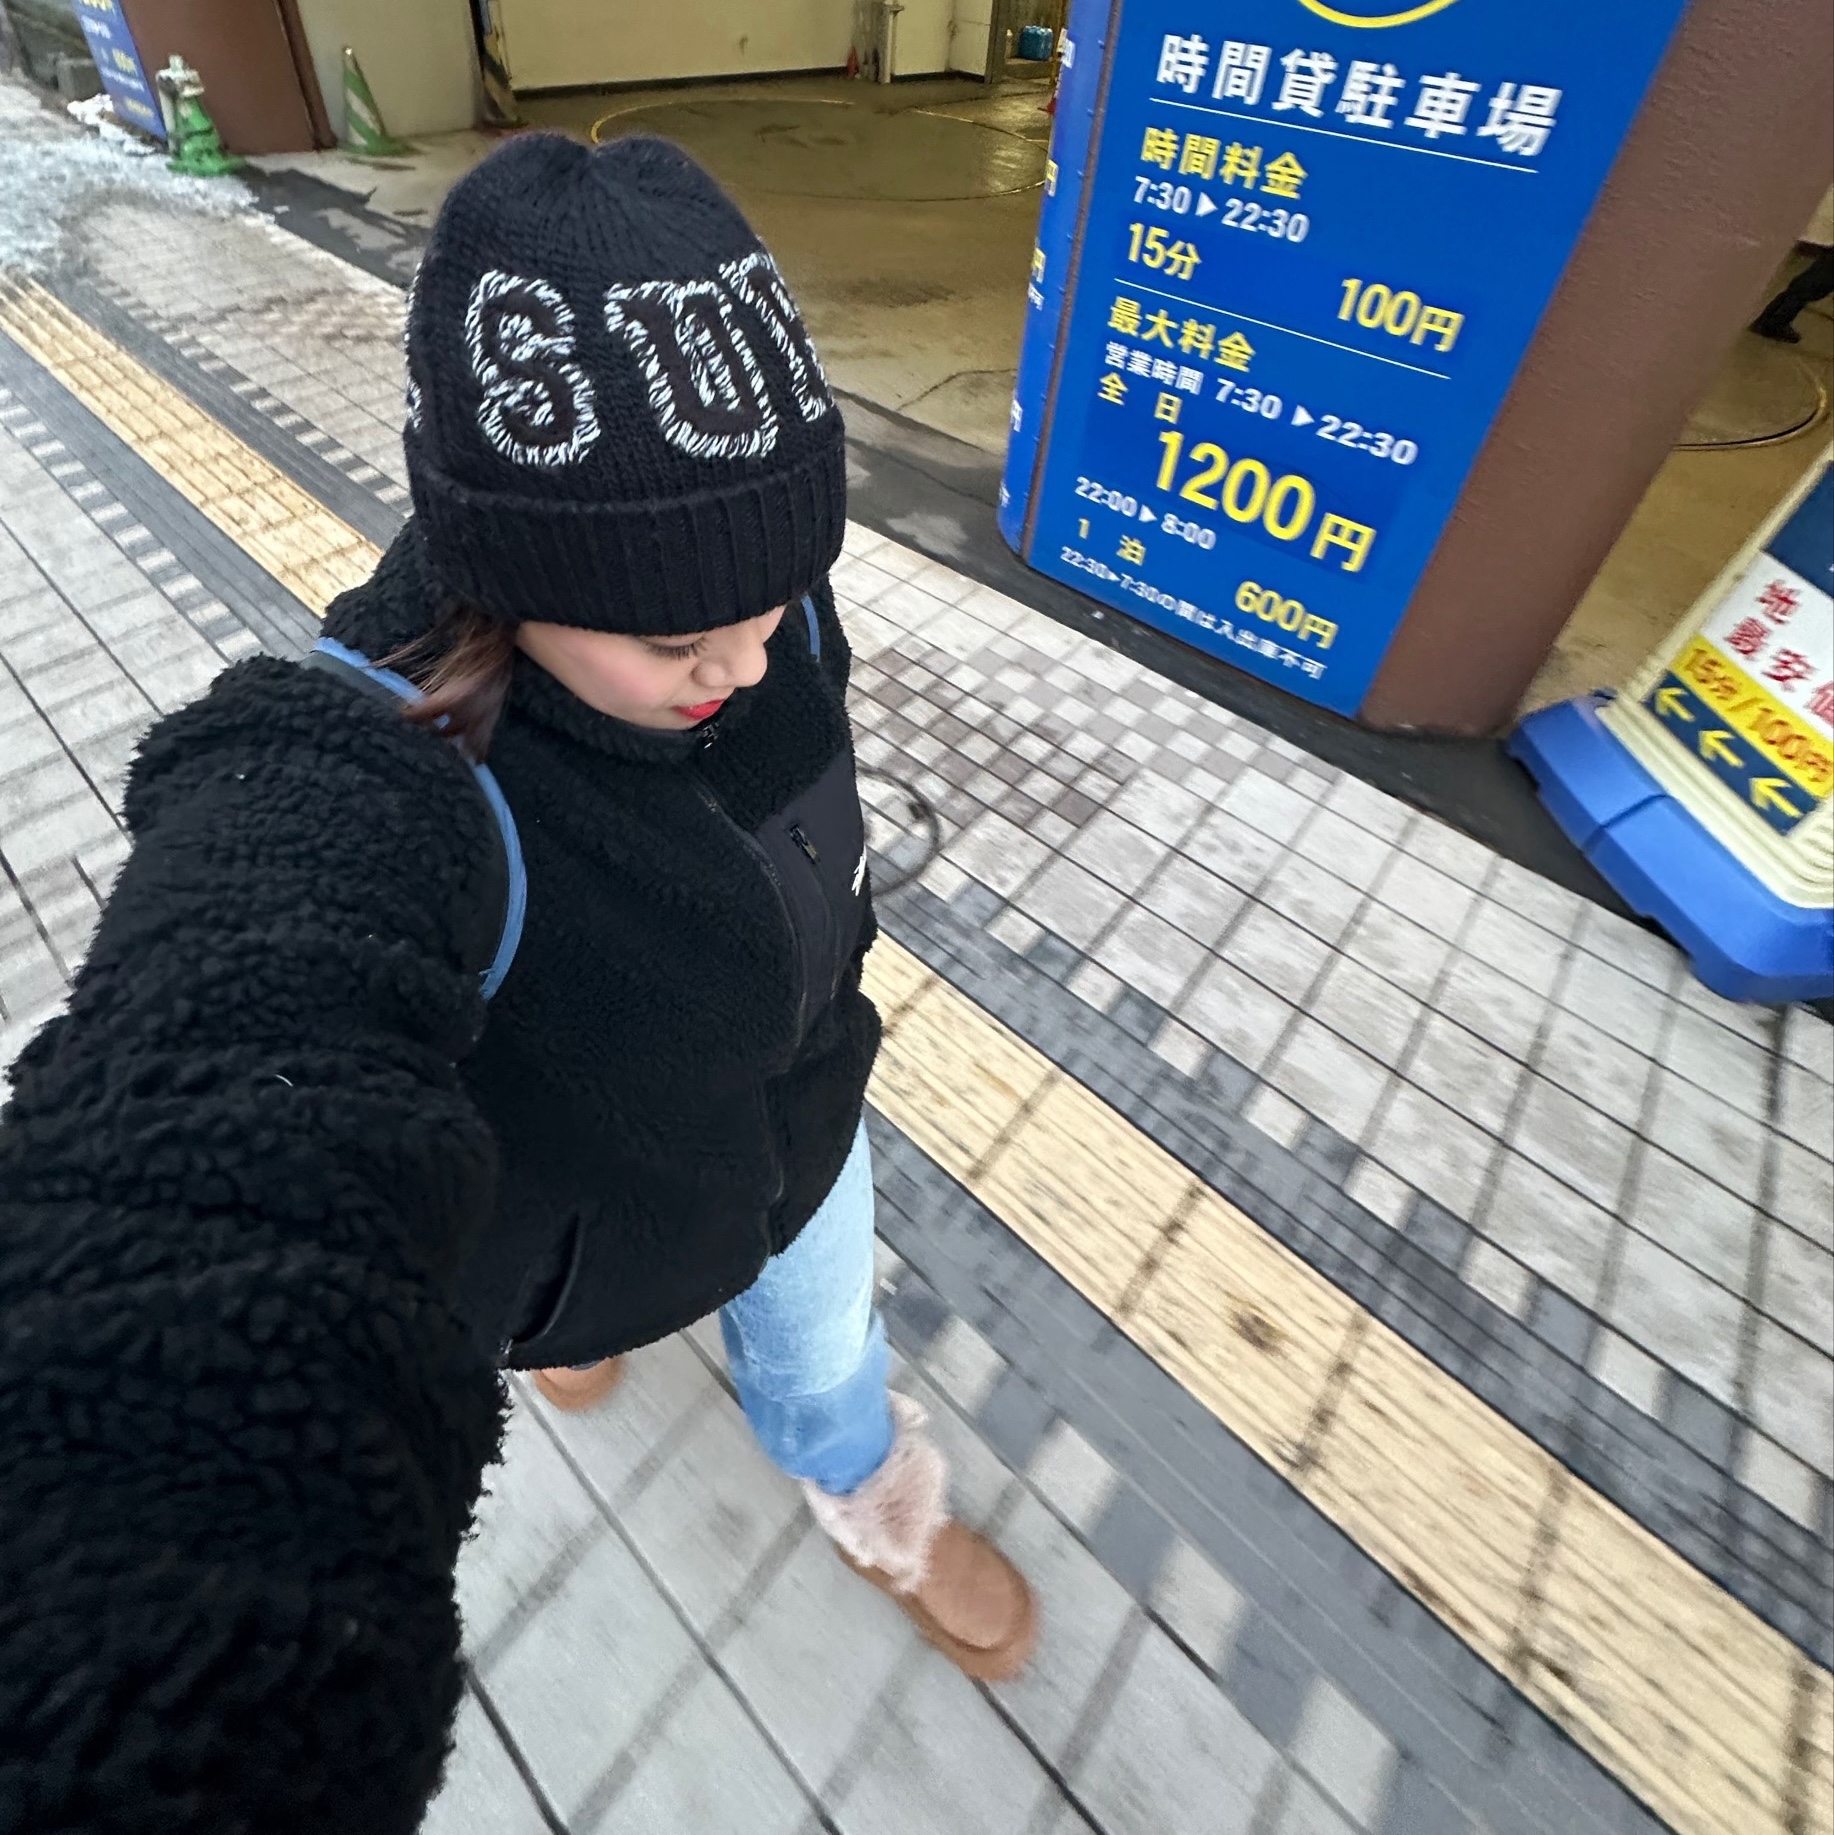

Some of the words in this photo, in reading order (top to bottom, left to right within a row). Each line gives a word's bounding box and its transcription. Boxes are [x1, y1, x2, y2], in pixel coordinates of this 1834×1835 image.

[1156, 33, 1563, 156] 時間貸駐車場
[1140, 126, 1308, 199] 時間料金
[1133, 176, 1192, 214] 7:30
[1221, 198, 1310, 243] 22:30
[1127, 222, 1202, 281] 15分
[1107, 296, 1256, 372] 最大料金
[1336, 277, 1465, 352] 100円
[1104, 341, 1205, 395] 営業時間
[1216, 377, 1283, 420] 7:30
[1315, 414, 1419, 466] 22:30
[1074, 476, 1138, 518] 22:00
[1160, 512, 1217, 550] 8:00
[1156, 430, 1377, 573] 1200円
[1234, 580, 1339, 650] 600円
